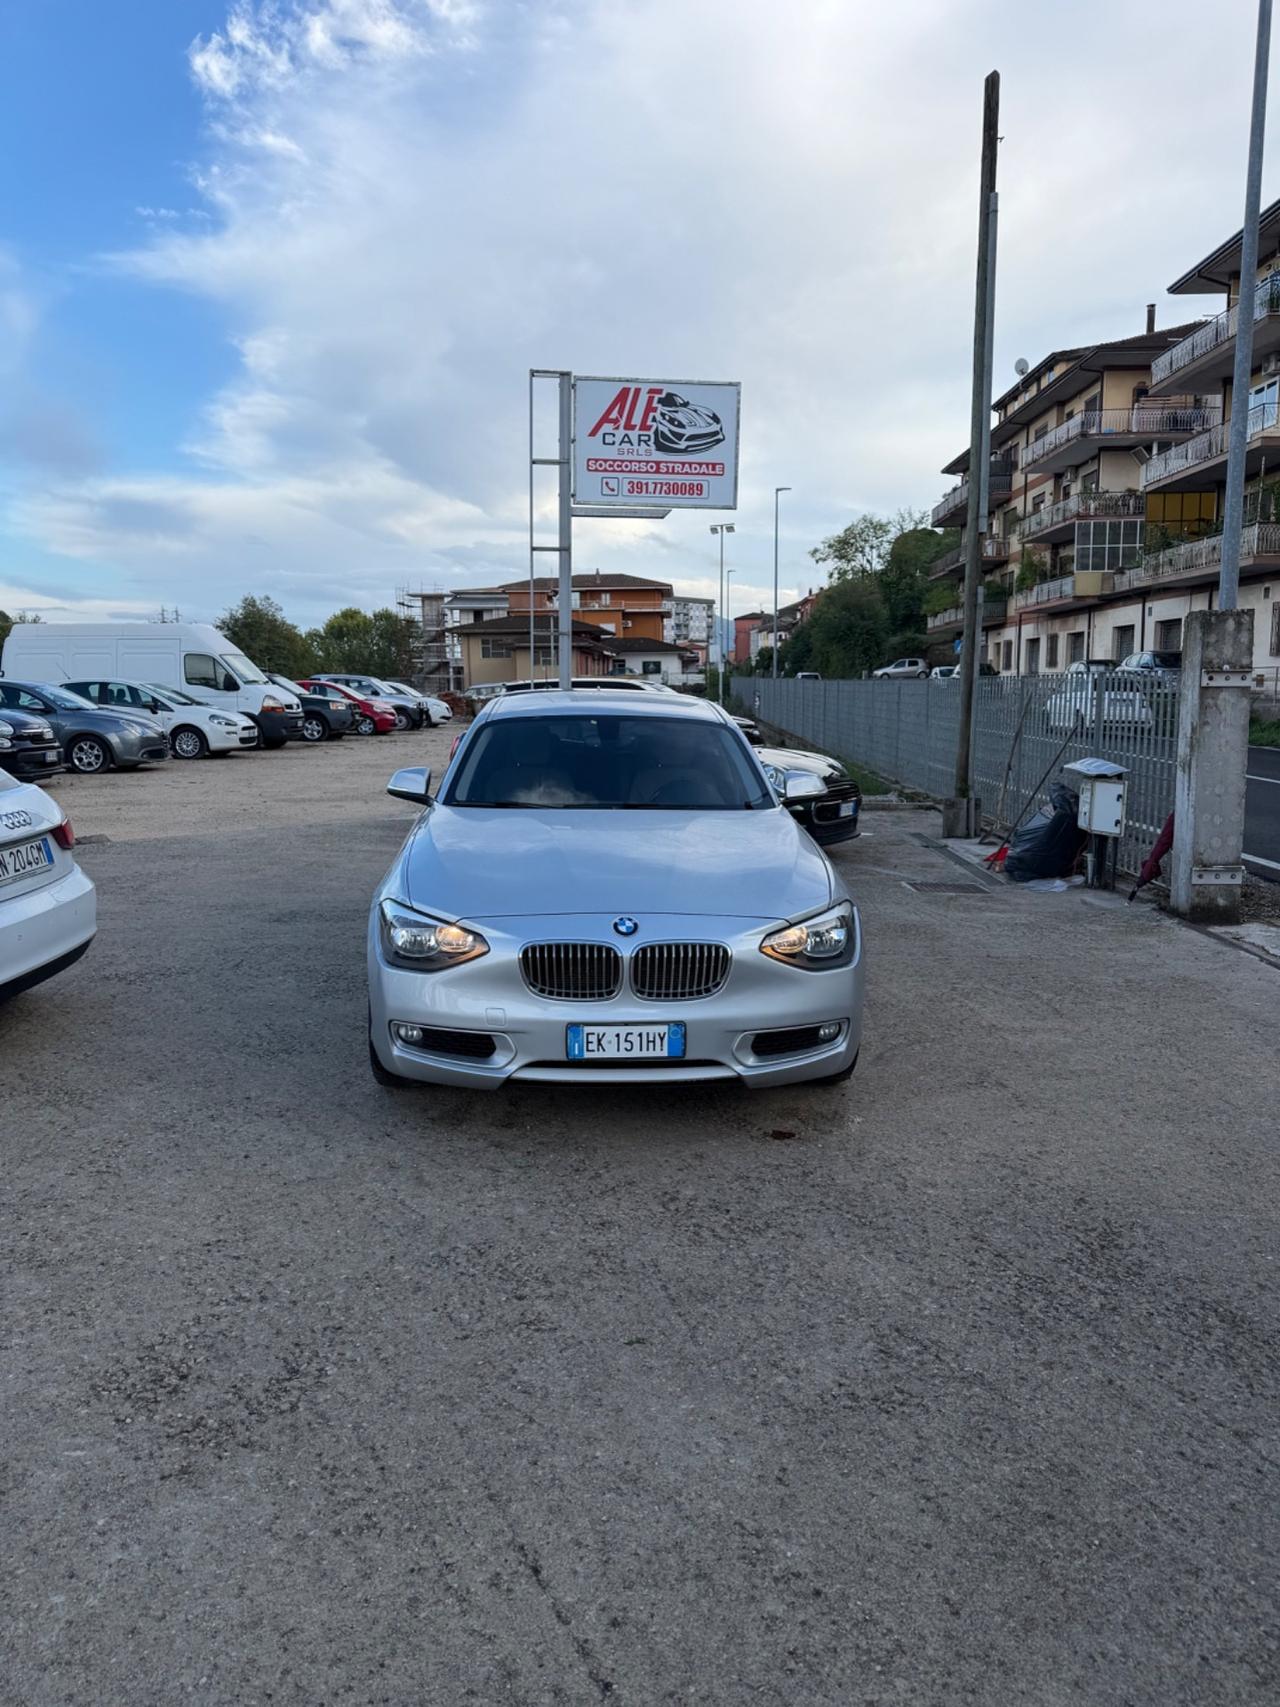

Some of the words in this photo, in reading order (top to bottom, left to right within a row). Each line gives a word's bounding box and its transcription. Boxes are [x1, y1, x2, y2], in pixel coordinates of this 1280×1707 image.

[587, 386, 664, 437] ALE
[602, 432, 651, 447] CAR
[617, 447, 653, 457] SRLS
[588, 460, 656, 473] SOCCORSO
[659, 462, 724, 475] STRADALE
[627, 480, 704, 496] 391.7730089
